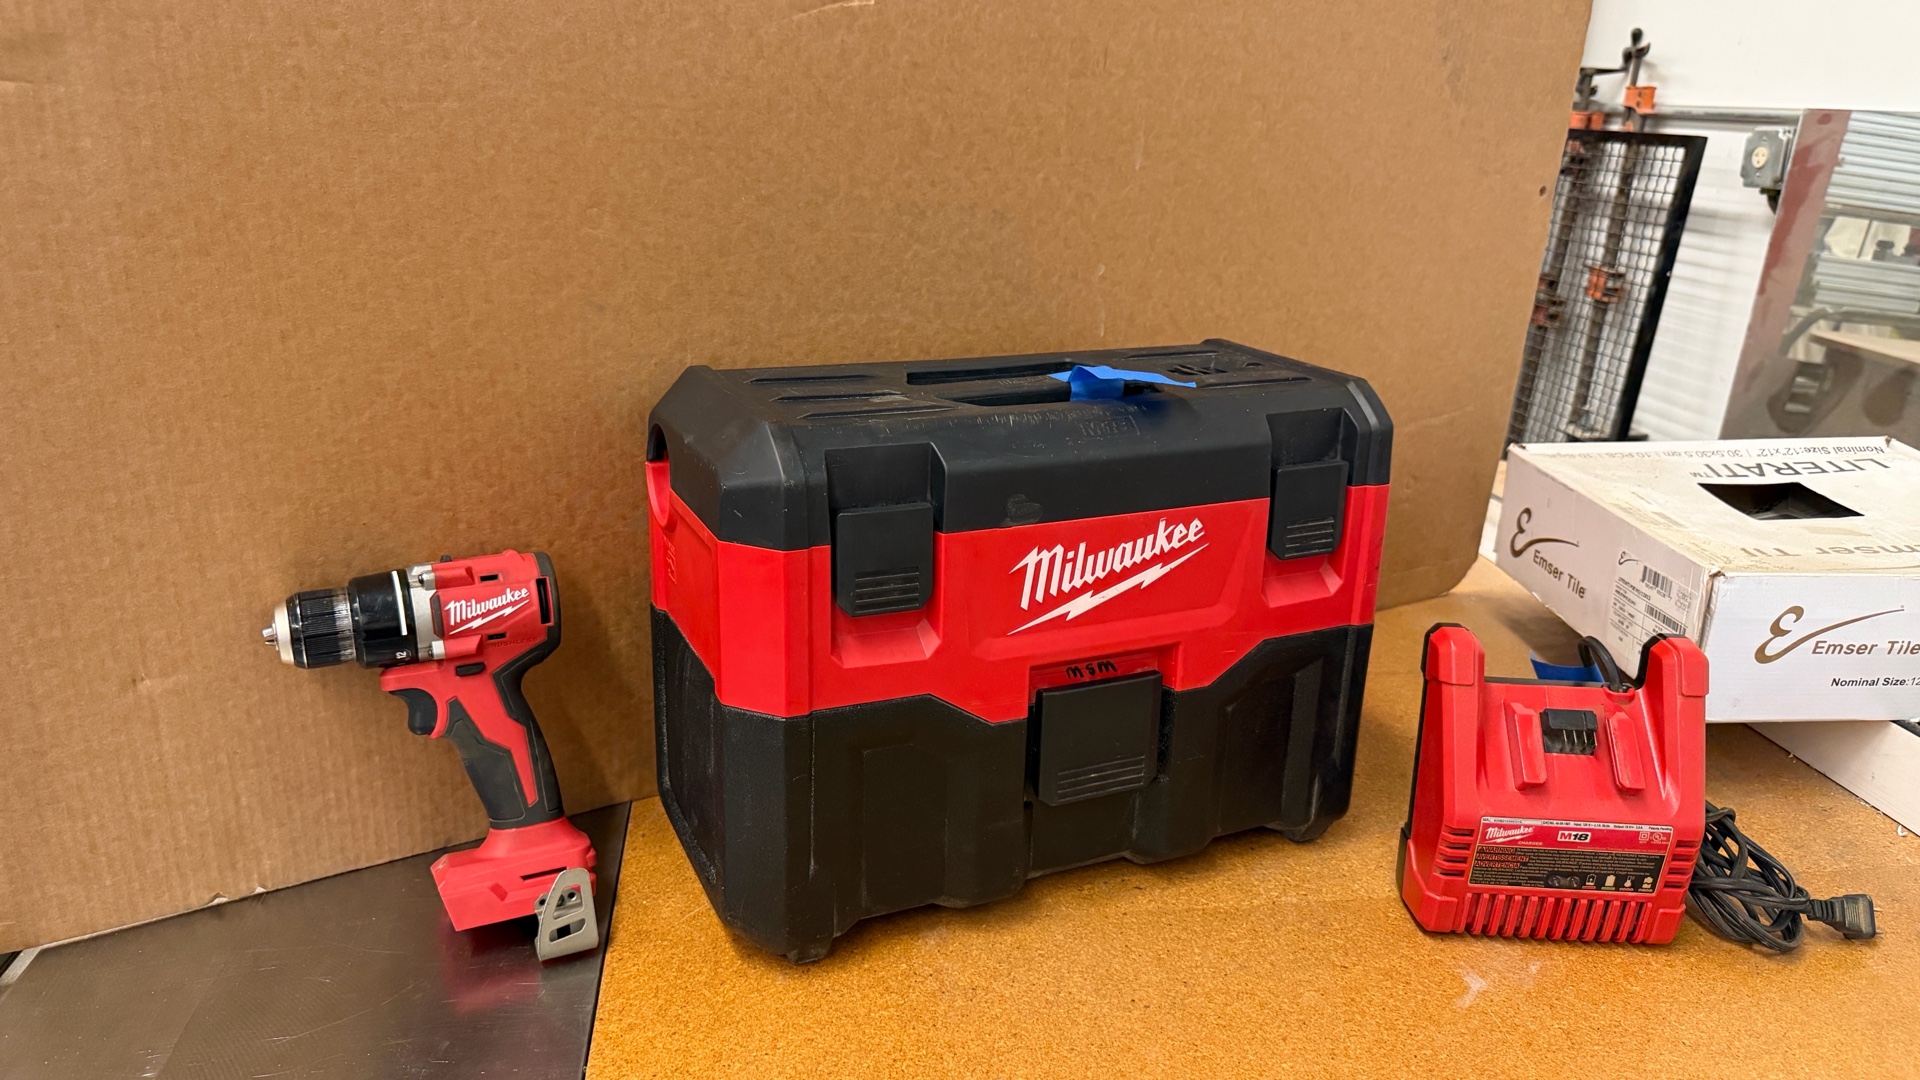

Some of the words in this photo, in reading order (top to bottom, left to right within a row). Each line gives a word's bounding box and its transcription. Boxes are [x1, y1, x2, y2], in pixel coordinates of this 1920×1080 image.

[1832, 445, 1886, 454] Nominal
[1815, 544, 1920, 556] mser
[1009, 517, 1205, 611] Milwaukee
[1532, 549, 1564, 582] Emser
[1567, 573, 1586, 599] Tile
[444, 587, 530, 626] Milwaukee
[1811, 640, 1879, 655] Emser
[396, 650, 407, 660] 12
[1830, 677, 1880, 687] Nominal
[1485, 825, 1535, 840] Milwaukee
[1559, 831, 1590, 841] M18
